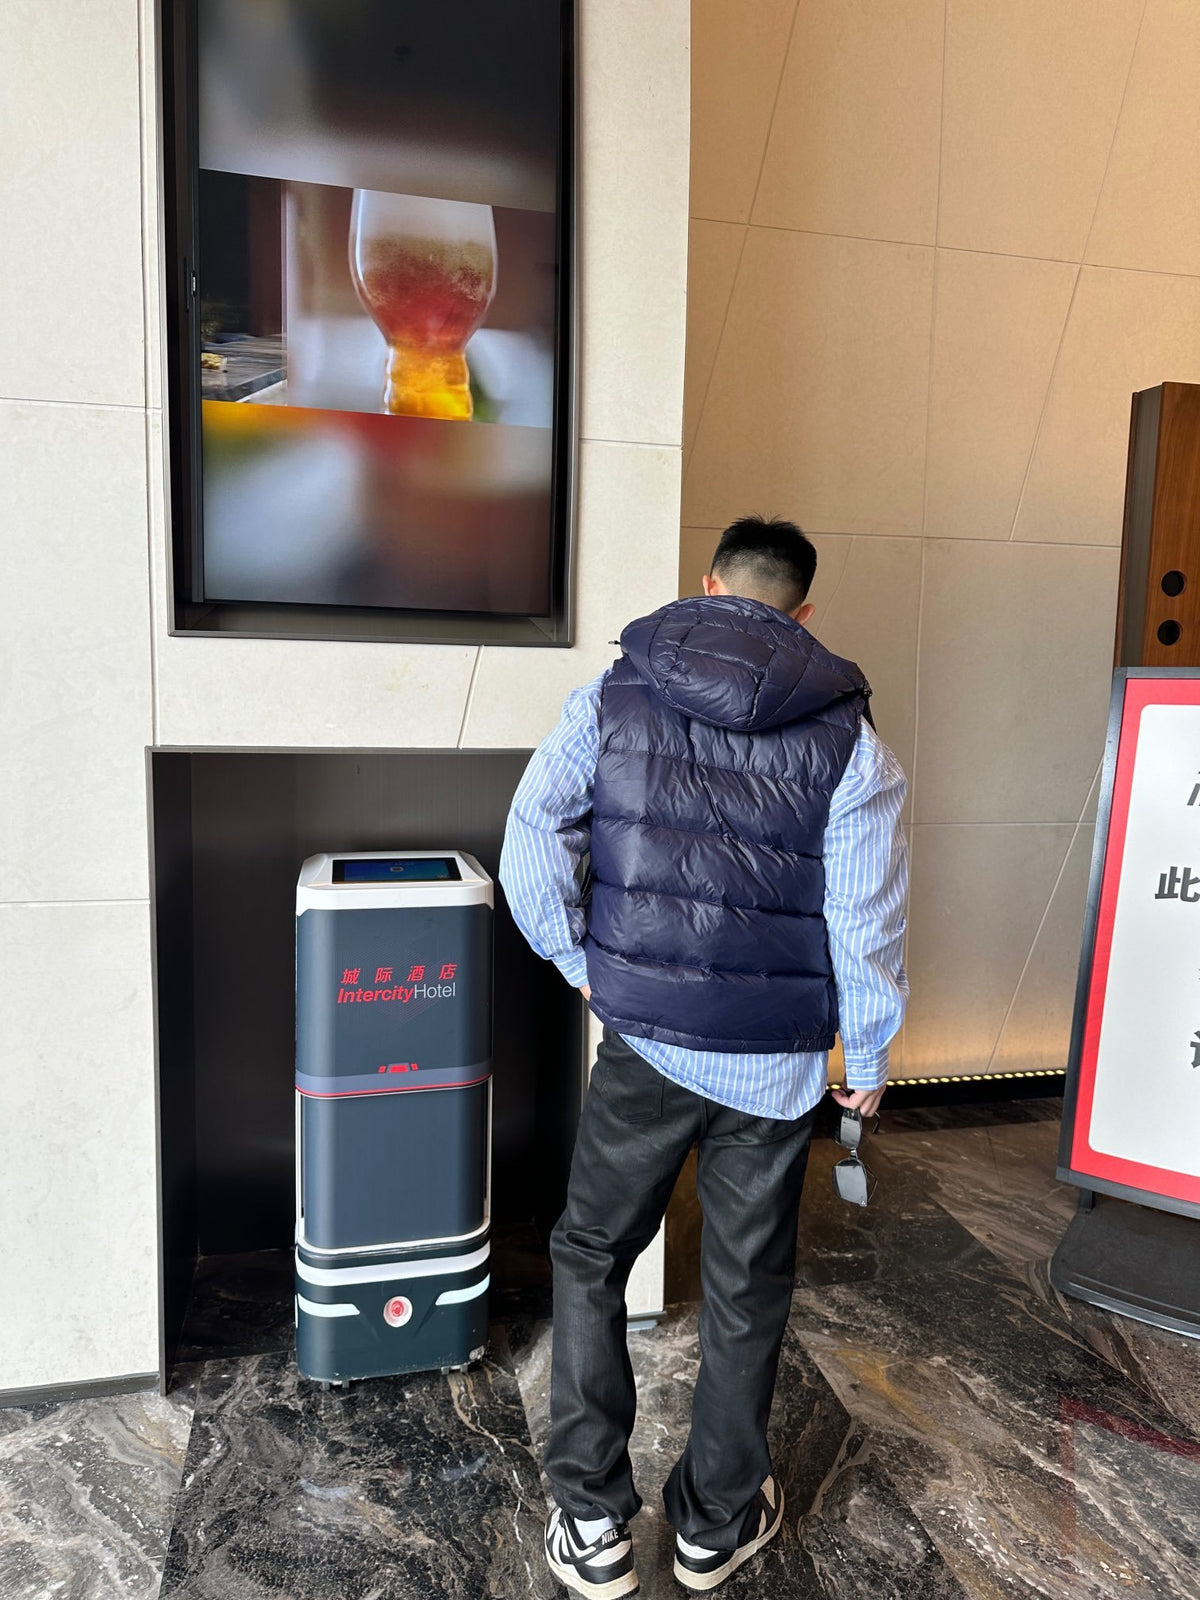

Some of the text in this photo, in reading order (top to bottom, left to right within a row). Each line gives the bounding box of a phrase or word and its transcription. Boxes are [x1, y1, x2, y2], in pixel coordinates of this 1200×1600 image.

[340, 963, 457, 985] 城际酒店
[337, 982, 456, 1003] IntercityHotel
[601, 1528, 619, 1546] NIKE
